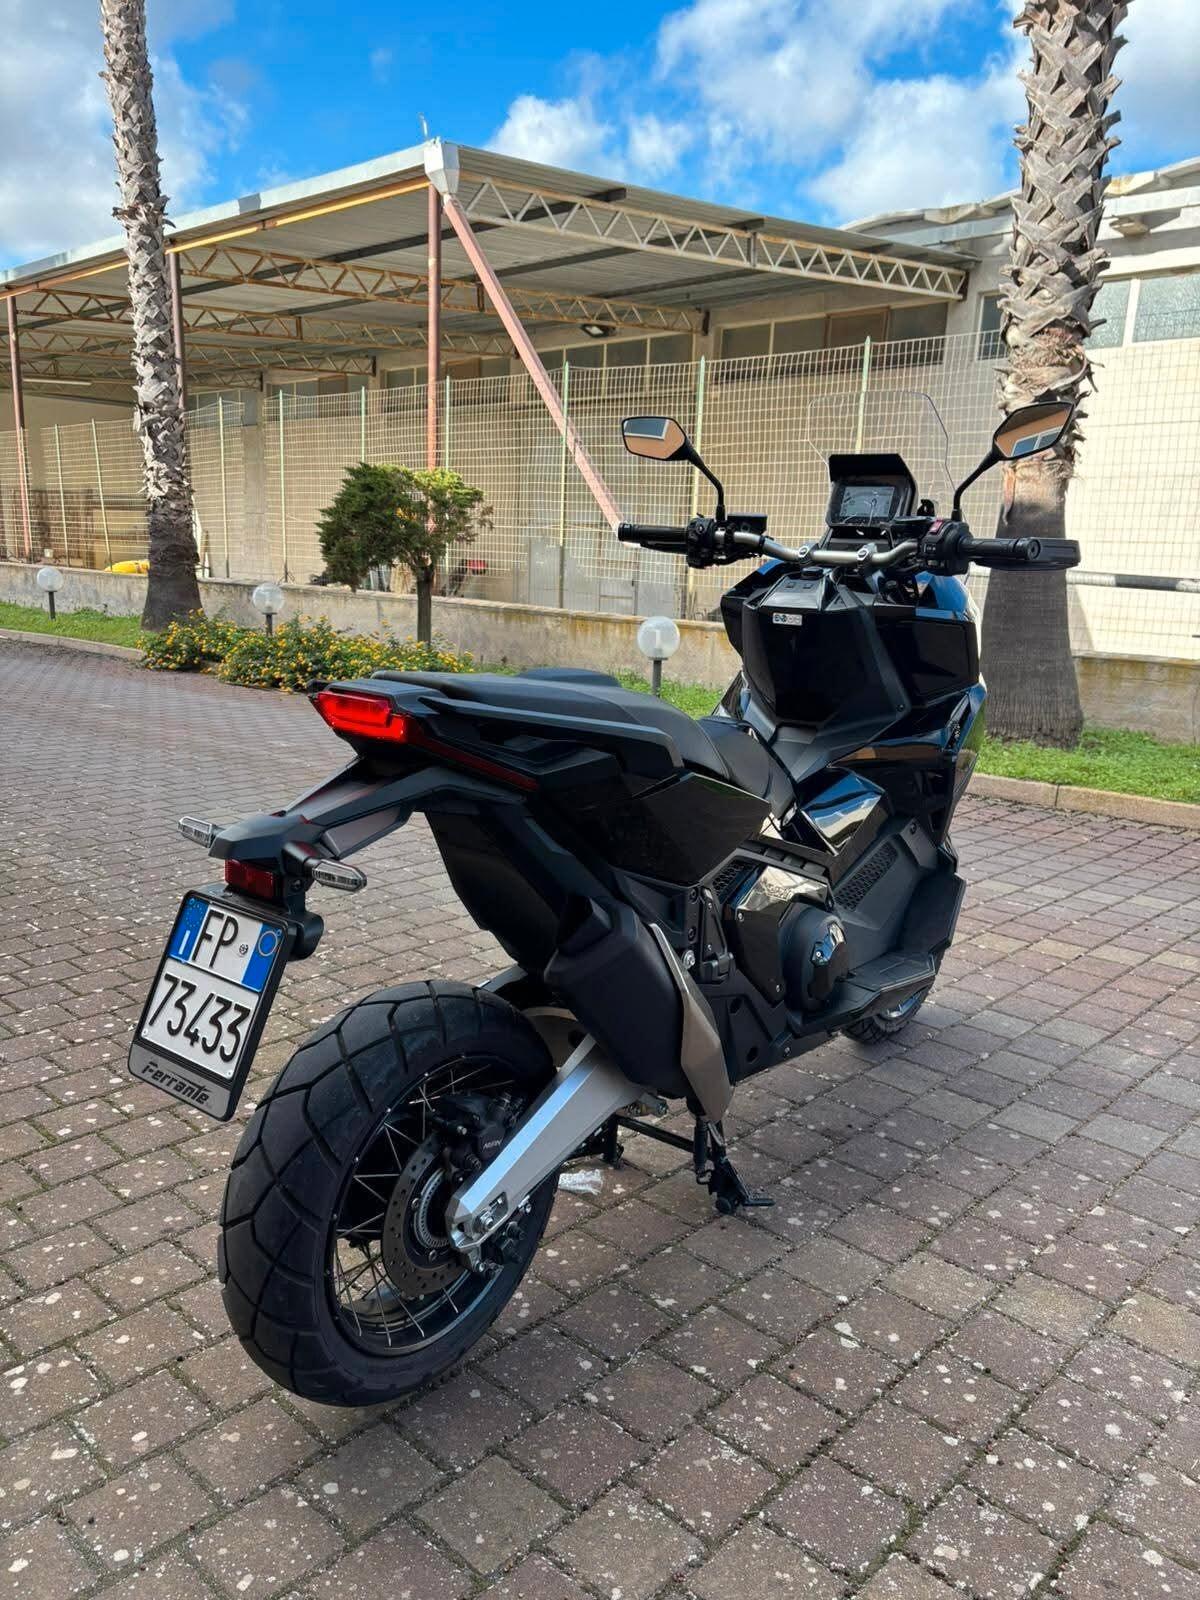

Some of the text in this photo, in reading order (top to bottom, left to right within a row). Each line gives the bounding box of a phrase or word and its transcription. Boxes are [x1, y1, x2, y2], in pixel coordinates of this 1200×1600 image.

[192, 908, 239, 969] FP
[148, 973, 251, 1063] 73433
[141, 1061, 211, 1105] Ferrante
